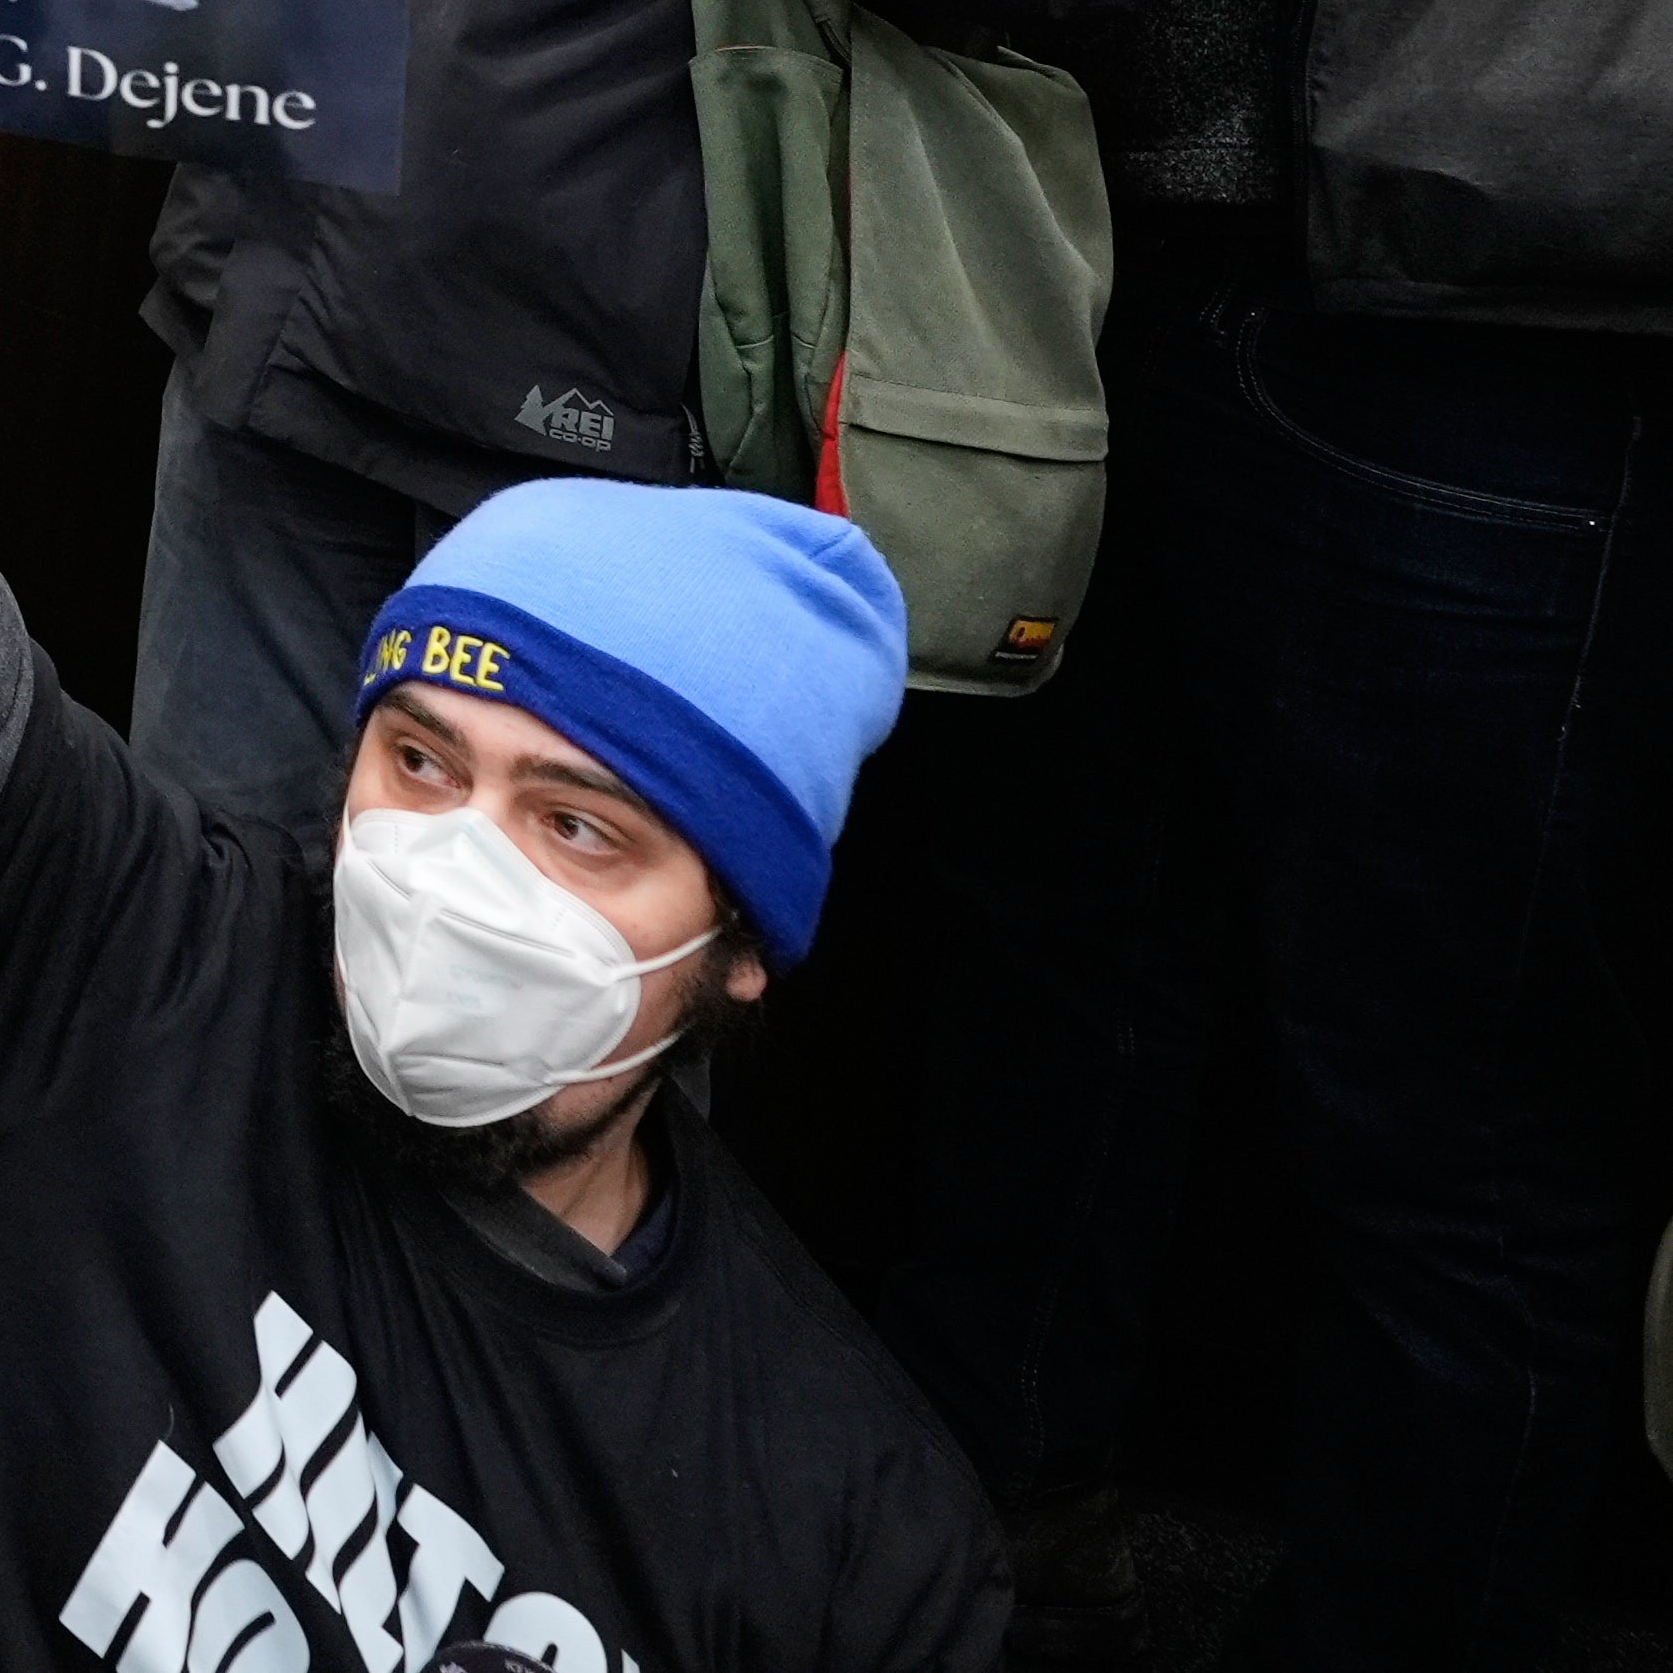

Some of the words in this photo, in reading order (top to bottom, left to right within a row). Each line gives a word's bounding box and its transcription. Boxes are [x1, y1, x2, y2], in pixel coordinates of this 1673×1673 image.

[65, 45, 318, 131] Dejene
[550, 406, 615, 442] REI
[421, 624, 511, 692] BEE
